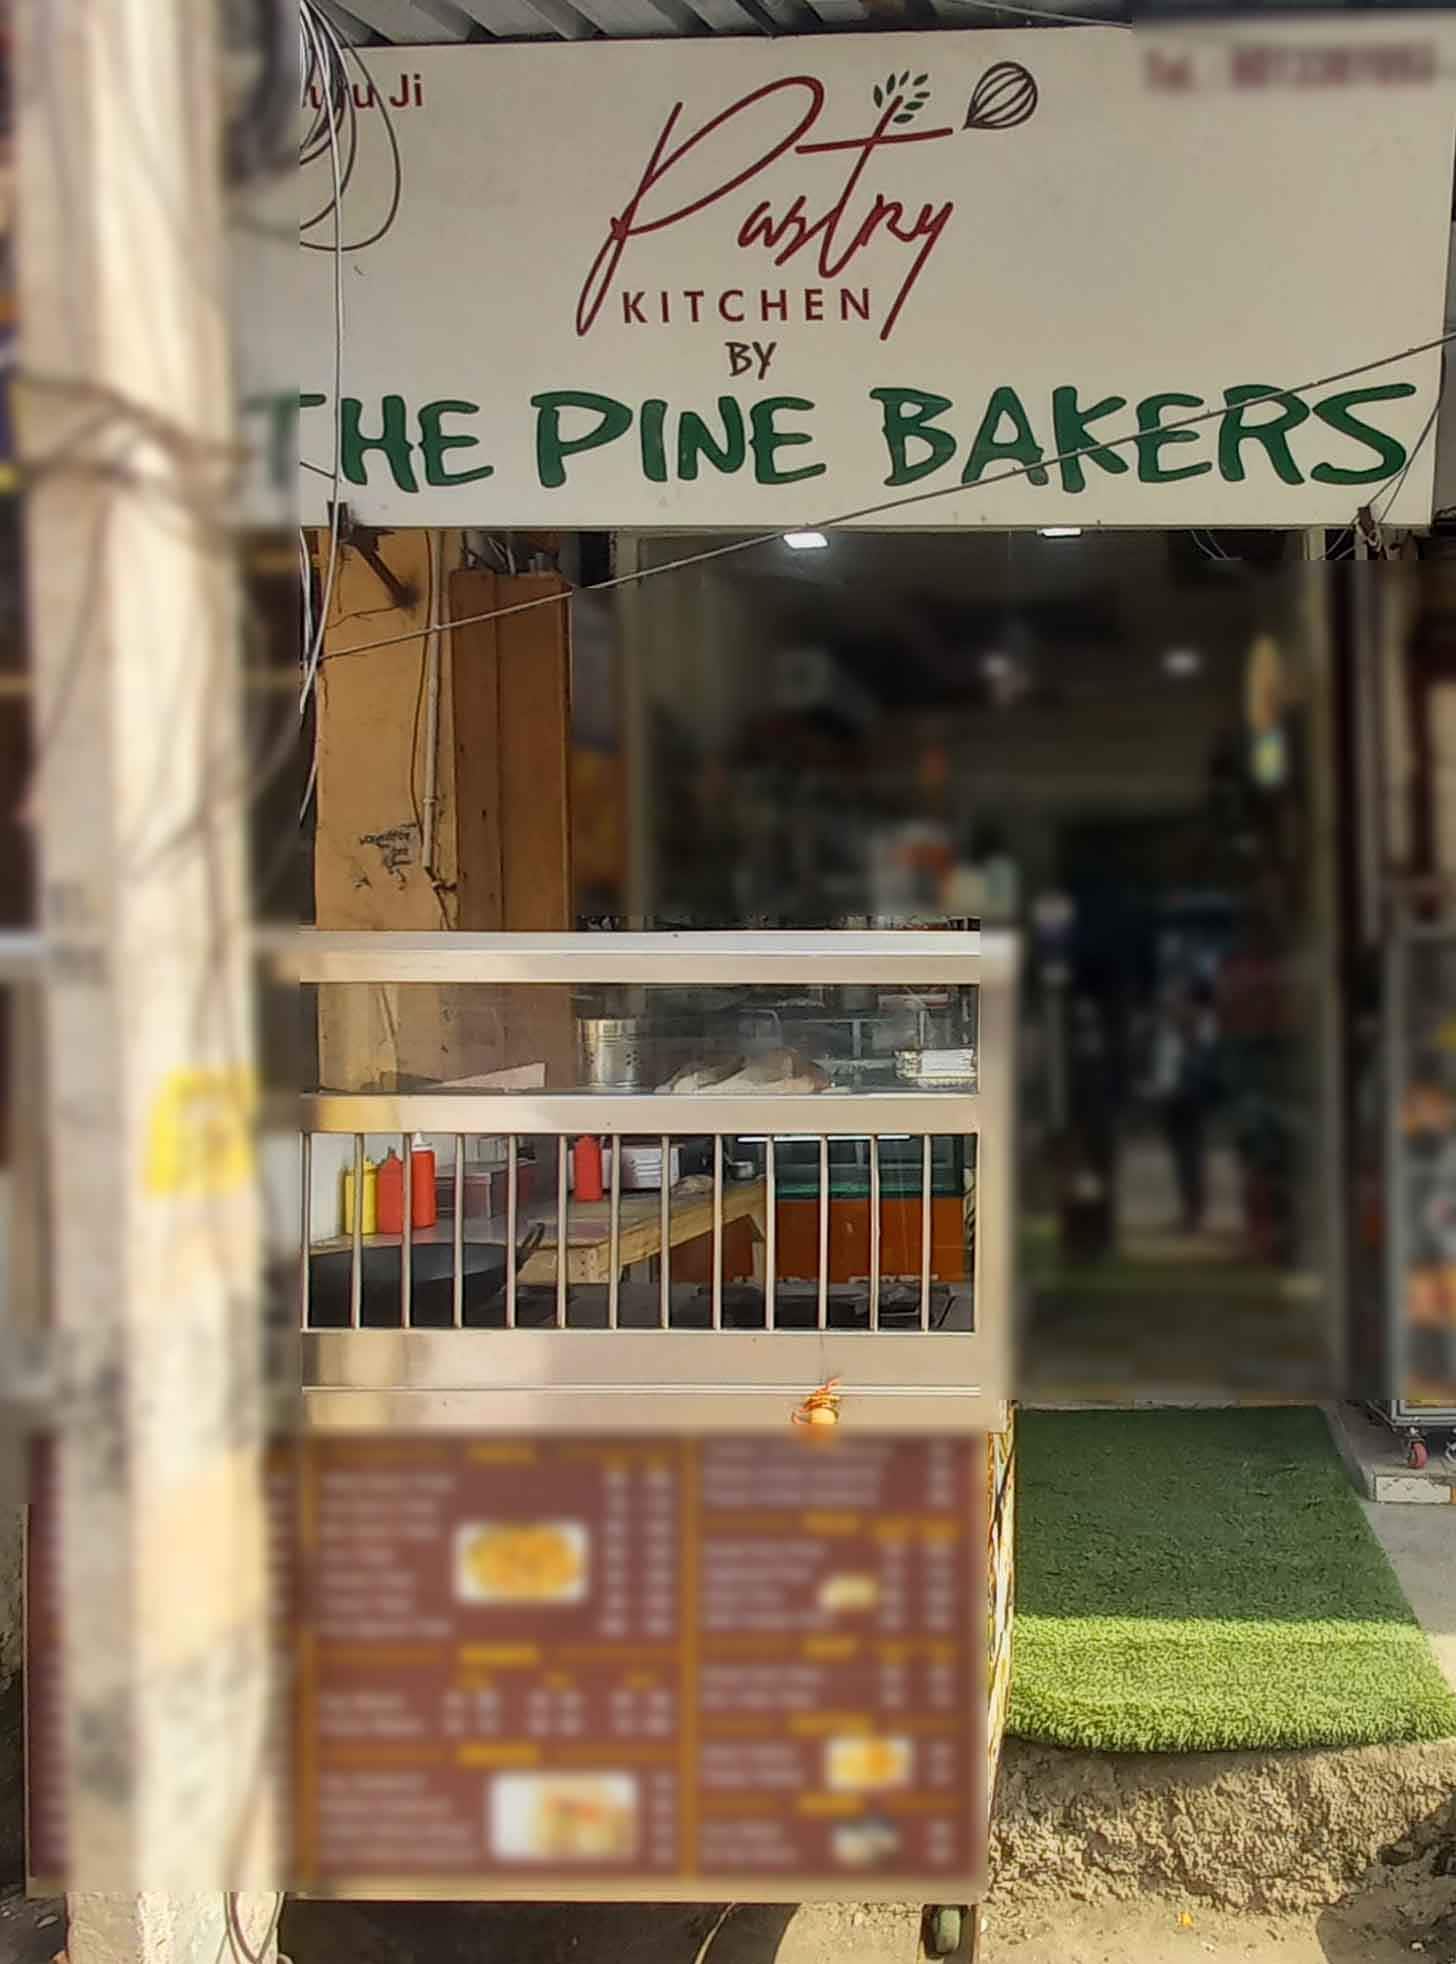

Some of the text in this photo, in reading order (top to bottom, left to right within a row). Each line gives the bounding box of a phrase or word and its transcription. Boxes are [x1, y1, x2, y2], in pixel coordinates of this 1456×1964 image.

[389, 73, 423, 108] Ji
[576, 75, 954, 341] Pastry
[622, 287, 871, 324] KITCHEN
[724, 341, 777, 380] BY
[530, 390, 827, 489] PINE
[869, 383, 1416, 493] BAKERS
